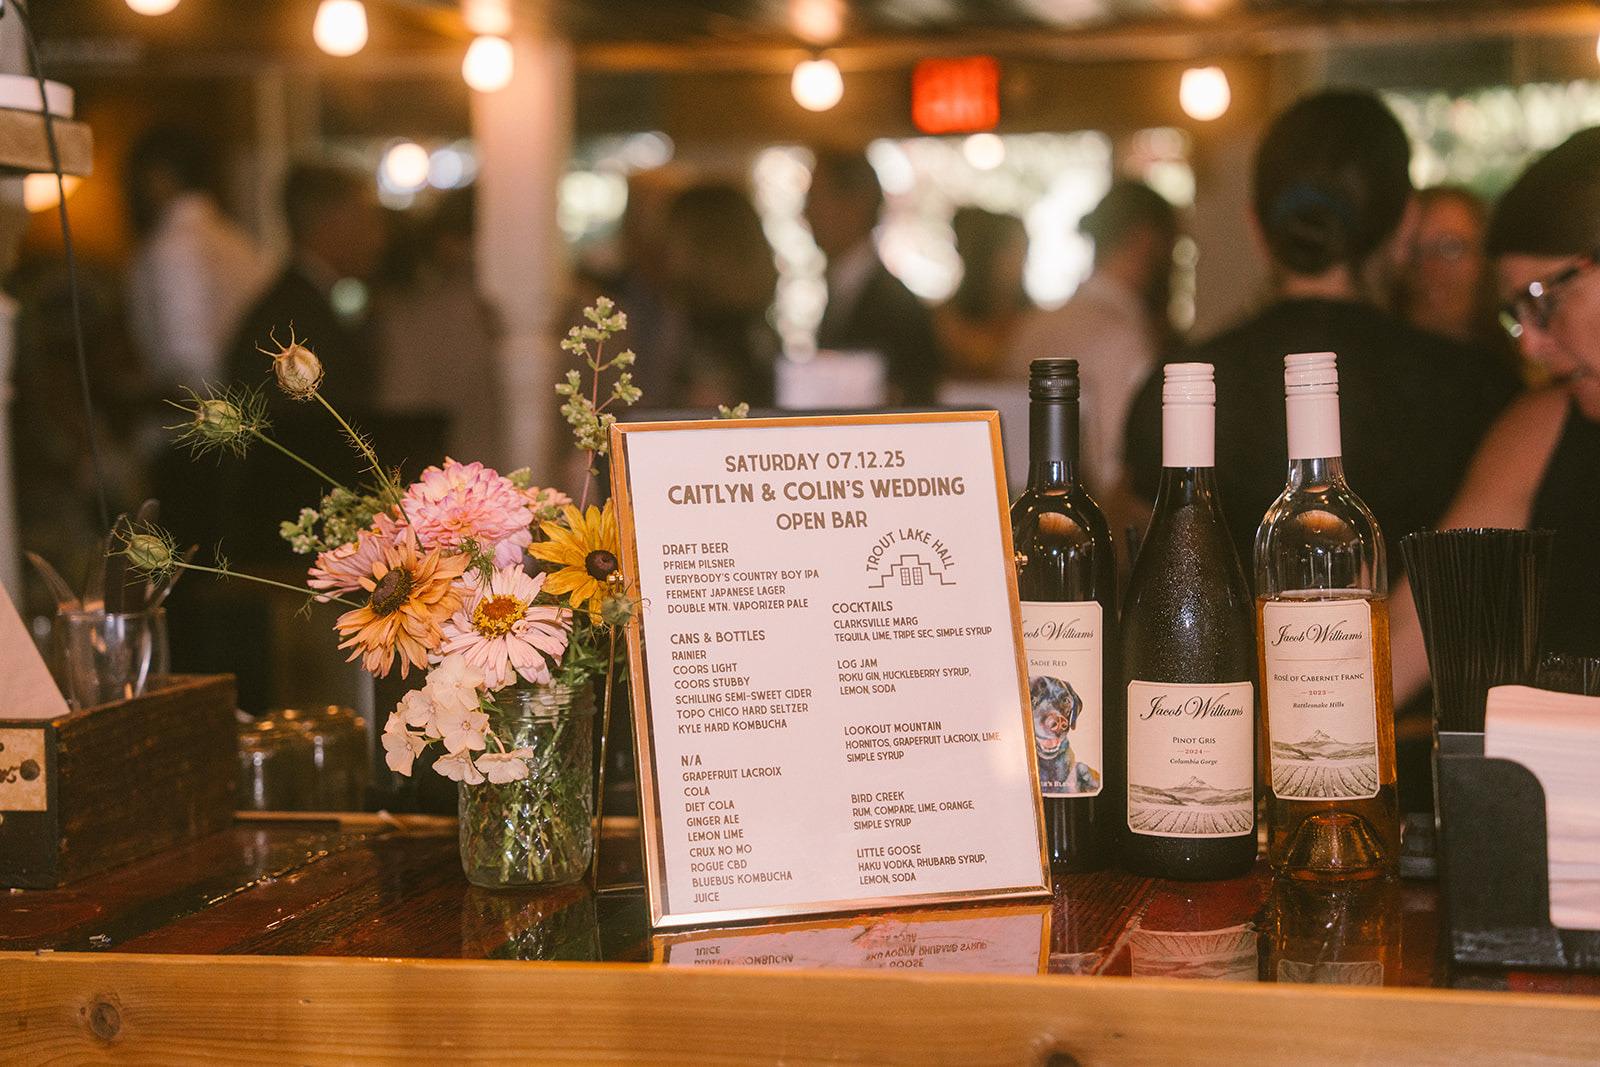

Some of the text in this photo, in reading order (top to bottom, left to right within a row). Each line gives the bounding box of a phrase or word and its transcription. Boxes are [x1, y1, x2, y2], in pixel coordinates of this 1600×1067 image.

[725, 450, 905, 473] SATURDAY 07.12.25
[668, 476, 965, 505] CAITLYN & COLIN'S WEDDING
[776, 510, 868, 530] OPEN BAR
[662, 542, 729, 555] DRAFT BEER
[866, 528, 955, 571] TROUT LAKE HALL
[663, 558, 735, 570] PFRIEM PILSNER
[665, 569, 819, 584] EVERYBODY'S COUNTRY BOY IPA
[666, 585, 786, 599] FERMENT JAPANESE LAGER
[668, 598, 808, 614] DOUBLE MTN. VAPORIZER PALE
[832, 600, 893, 614] COCKTAILS
[833, 616, 918, 629] CLARKSVILLE MARG
[1041, 618, 1094, 640] Williams
[670, 630, 765, 645] CANS & BOTTLES
[834, 626, 992, 642] TEQUILA, LIME, TRIPE SEC, SIMPLE SYRUP
[1271, 620, 1363, 646] Jacob Williams
[671, 650, 707, 661] RAINIER
[673, 662, 737, 675] COORS LIGHT
[837, 658, 878, 669] LOG JAM
[838, 667, 971, 682] ROKU GIN, HUCKLEBERRY SYRUP,
[674, 676, 750, 690] COORS STUBBY
[840, 684, 896, 695] LEMON, SODA
[675, 688, 812, 705] SCHILLING SEMI-SWEET CIDER
[676, 703, 808, 719] TOPO CHICO HARD SELTZER
[1140, 692, 1244, 720] Jacob Williams
[678, 719, 787, 734] KYLE HARD KOMBUCHA
[844, 721, 942, 736] LOOKOUT MOUNTAIN
[845, 732, 1001, 749] HORNITOS, GRAPEFRUIT LACROIX, LIME,
[1172, 736, 1197, 744] PINOT
[681, 754, 702, 767] N/A
[846, 750, 904, 763] SIMPLE SYRUP
[682, 766, 782, 782] GRAPEFRUIT LACROIX
[684, 786, 710, 797] COLA
[851, 791, 905, 804] BIRD CREEK
[685, 800, 735, 812] DIET COLA
[852, 800, 975, 817] RUM, COMPARE, LIME, ORANGE,
[686, 814, 739, 827] GINGER ALE
[853, 817, 912, 830] SIMPLE SYRUP
[688, 828, 744, 842] LEMON LIME
[689, 844, 752, 858] CRUX NO MO
[857, 844, 922, 858] LITTLE GOOSE
[691, 859, 747, 872] ROGUE CBD
[858, 854, 987, 871] HAKU VODKA, RHUBARB SYRUP,
[692, 871, 793, 887] BLUEBUS KOMBUCHA
[859, 872, 917, 885] LEMON, SODA
[694, 892, 720, 903] JUICE
